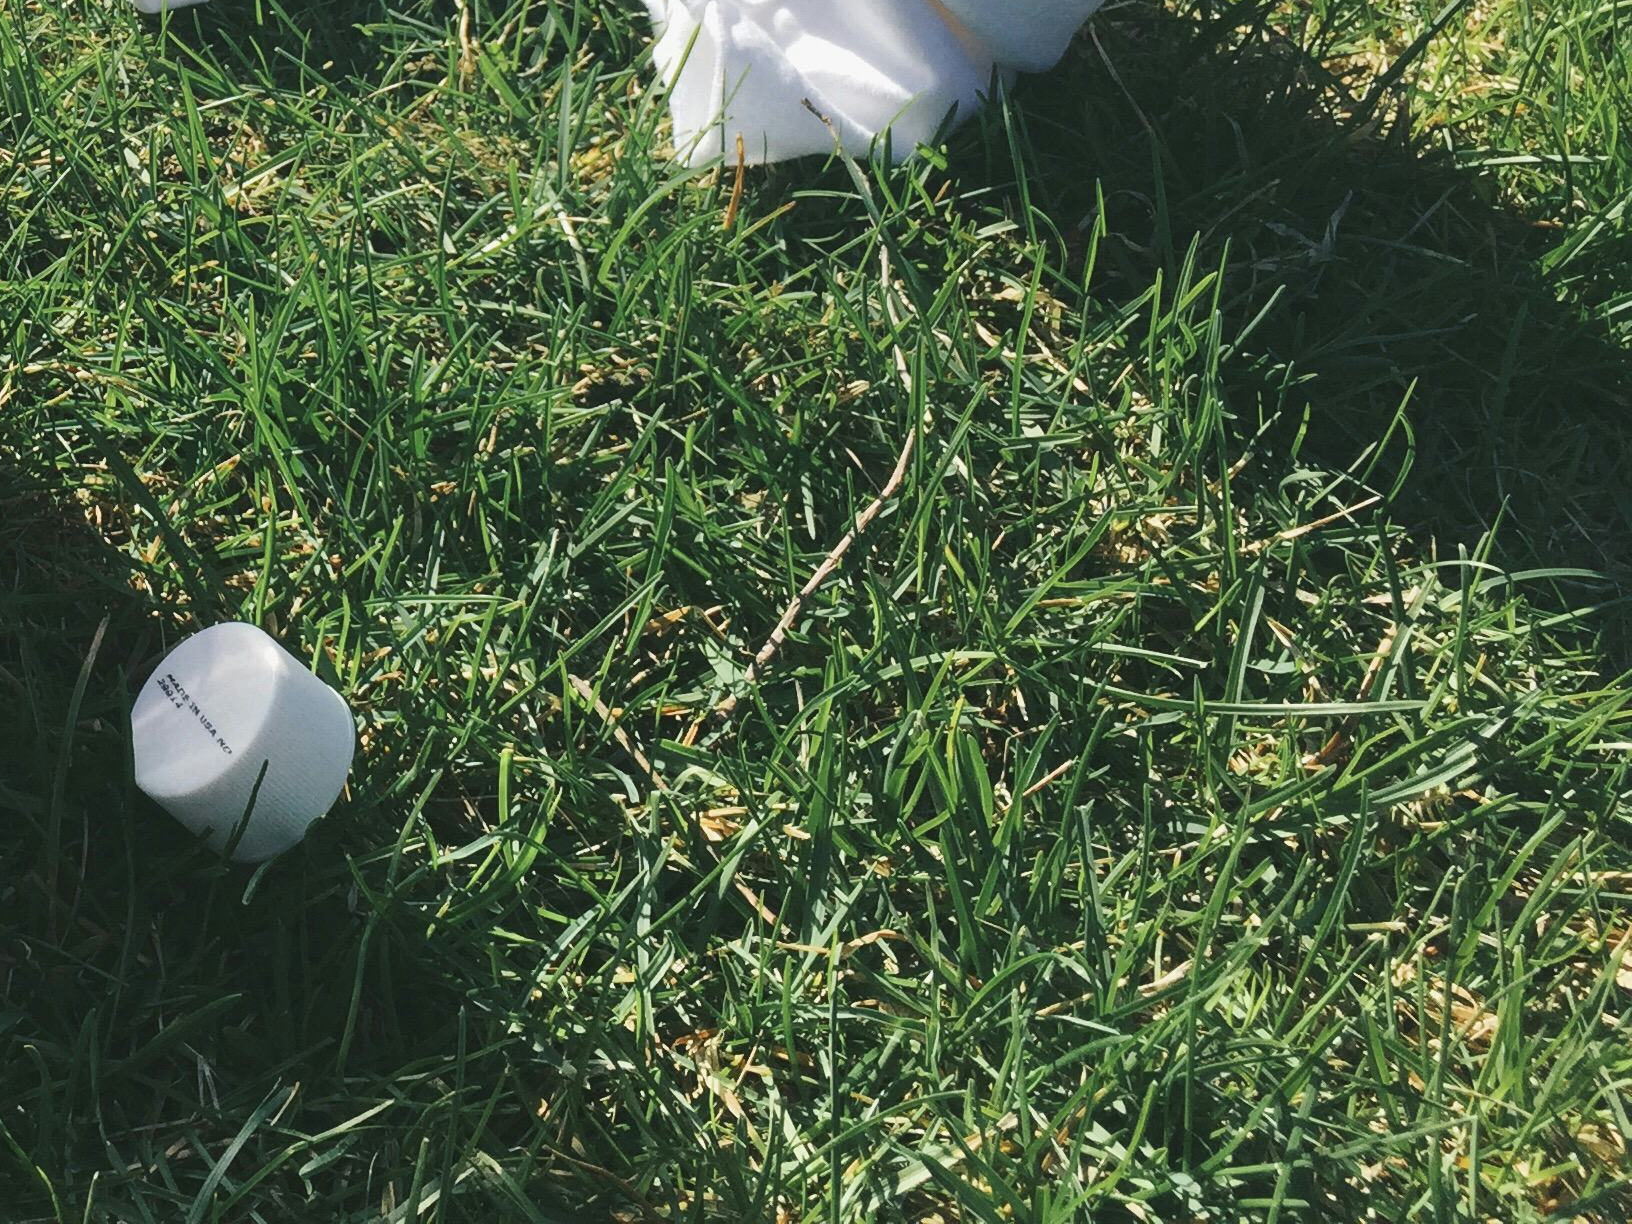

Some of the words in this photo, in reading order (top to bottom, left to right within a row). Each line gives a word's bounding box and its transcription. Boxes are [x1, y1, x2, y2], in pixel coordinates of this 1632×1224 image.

[167, 674, 190, 702] MADE
[189, 702, 201, 716] IN
[199, 715, 217, 737] USA
